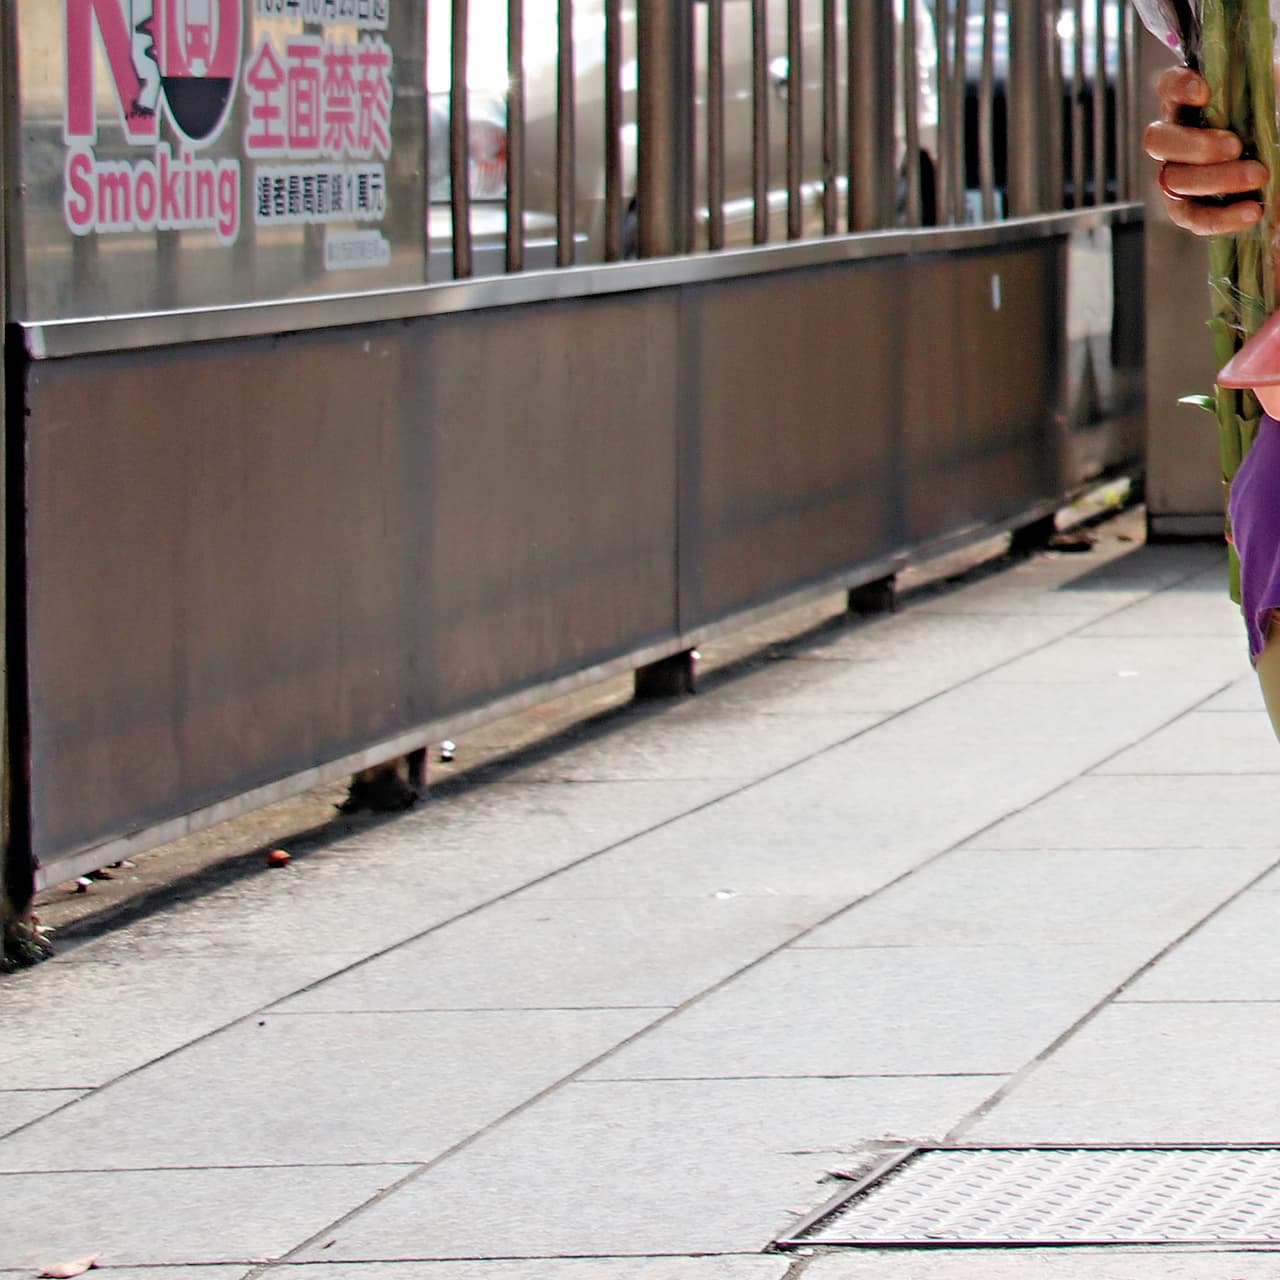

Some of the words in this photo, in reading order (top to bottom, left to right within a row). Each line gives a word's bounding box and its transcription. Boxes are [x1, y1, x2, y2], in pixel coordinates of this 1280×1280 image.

[247, 40, 392, 154] 全面禁菸
[68, 151, 238, 238] Smoking
